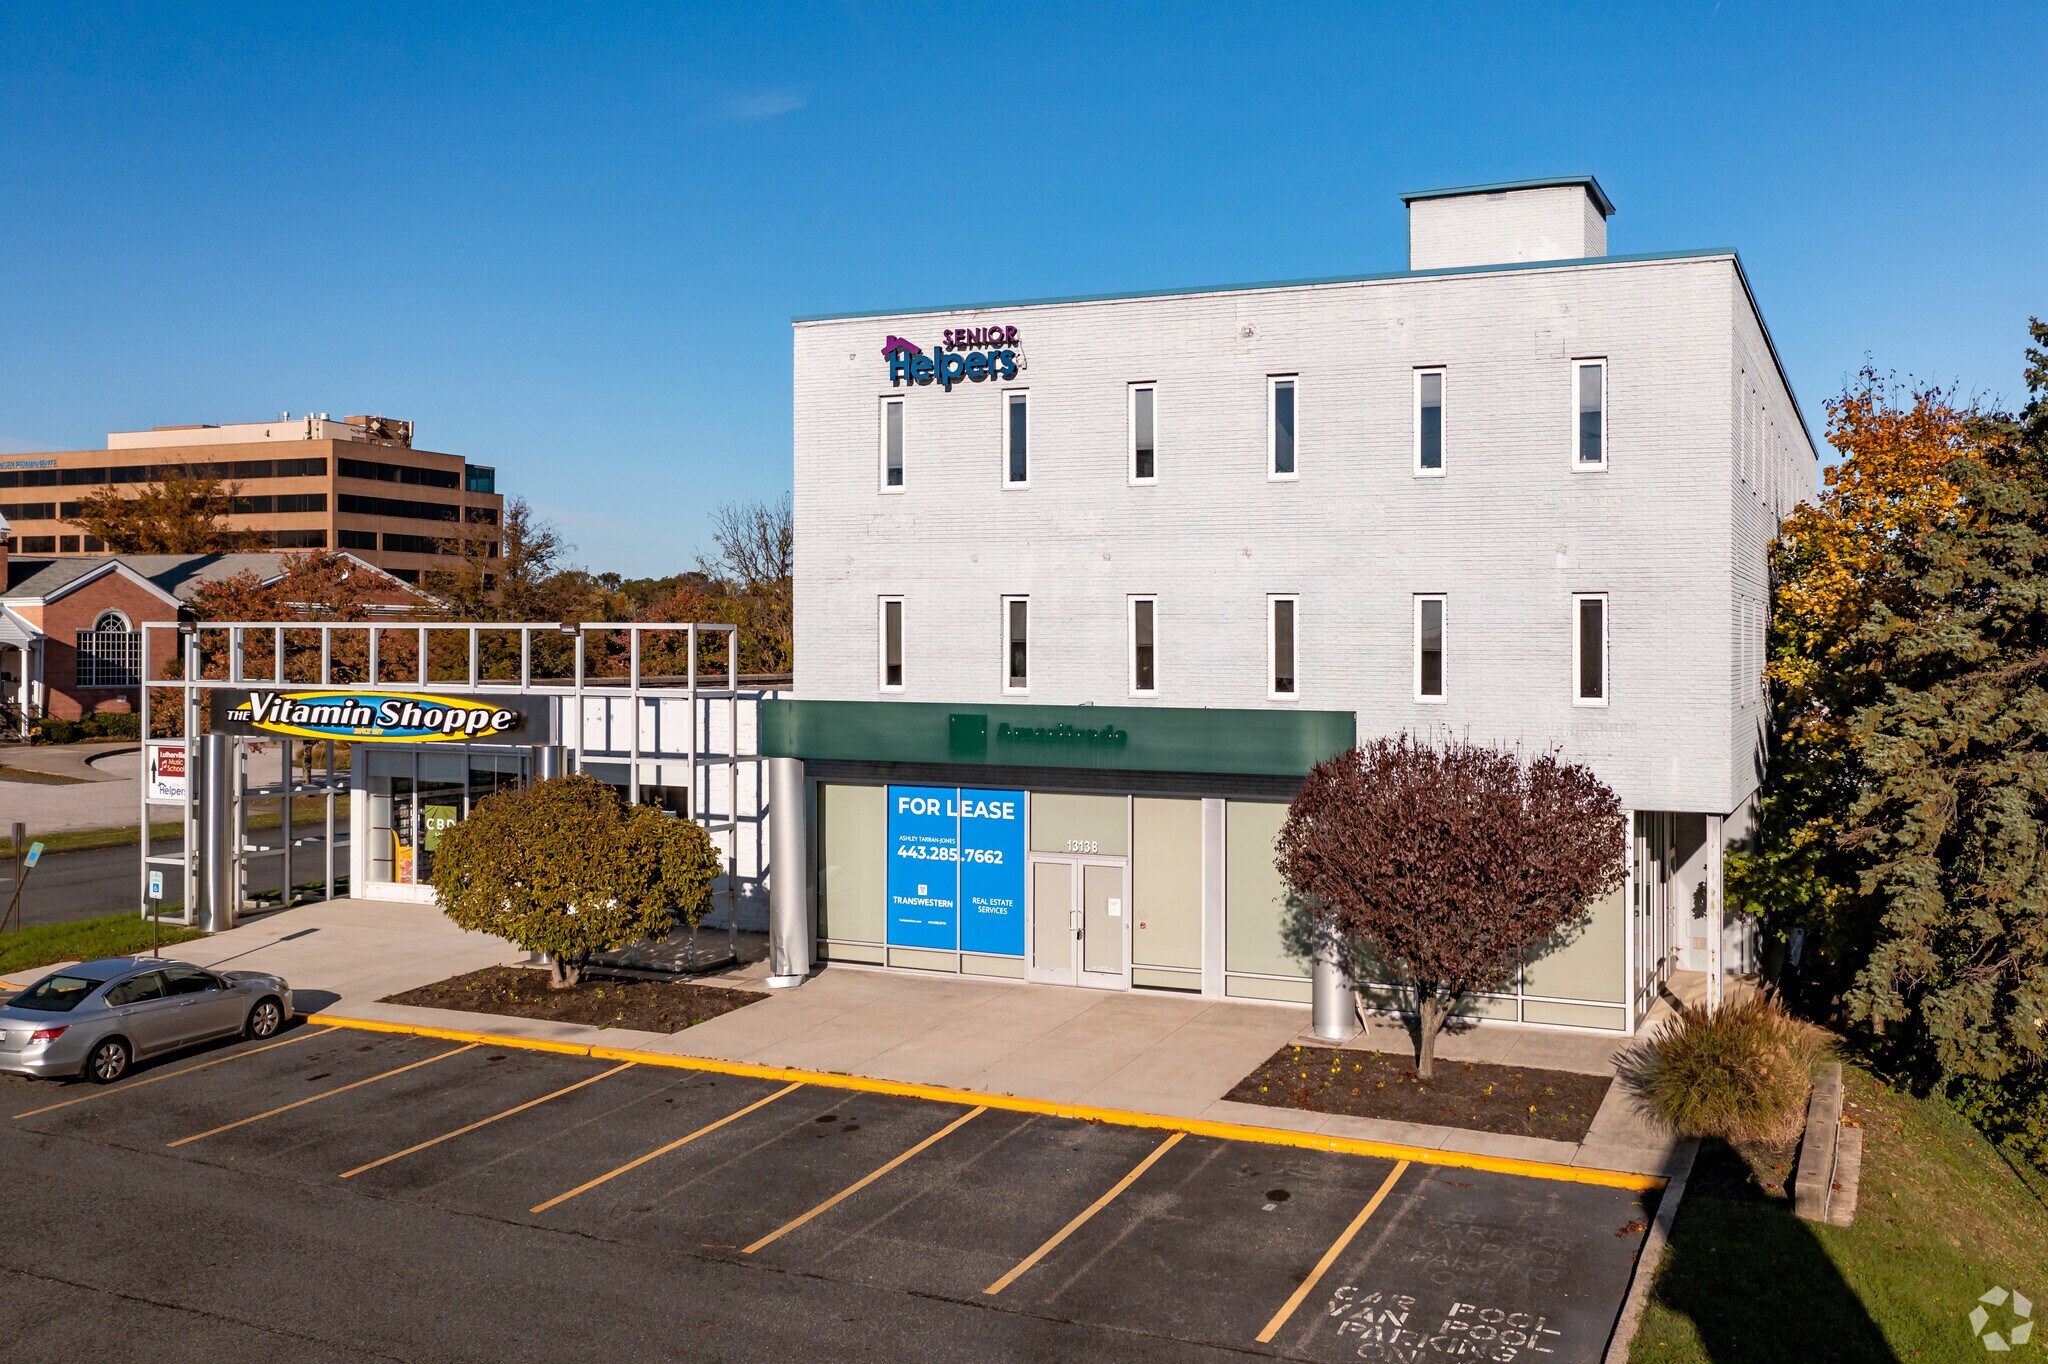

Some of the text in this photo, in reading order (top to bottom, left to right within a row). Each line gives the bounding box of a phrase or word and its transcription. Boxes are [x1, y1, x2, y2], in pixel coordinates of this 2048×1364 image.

[943, 325, 1018, 346] SENIOR
[890, 346, 1016, 386] Helpers
[227, 692, 512, 734] THE Vitamin Shoppe
[898, 797, 1015, 820] FOR LEASE
[427, 818, 456, 830] CBD
[919, 836, 956, 844] TARRAN-JONES
[897, 845, 1003, 864] 443.285.7662
[893, 896, 953, 908] TRANSWESTERN
[972, 897, 1013, 906] REAL ESTATE
[978, 906, 1008, 914] SERVICES
[1329, 1300, 1554, 1353] VAN POOL
[1448, 1302, 1561, 1335] POOL
[1337, 1320, 1518, 1362] PARKING
